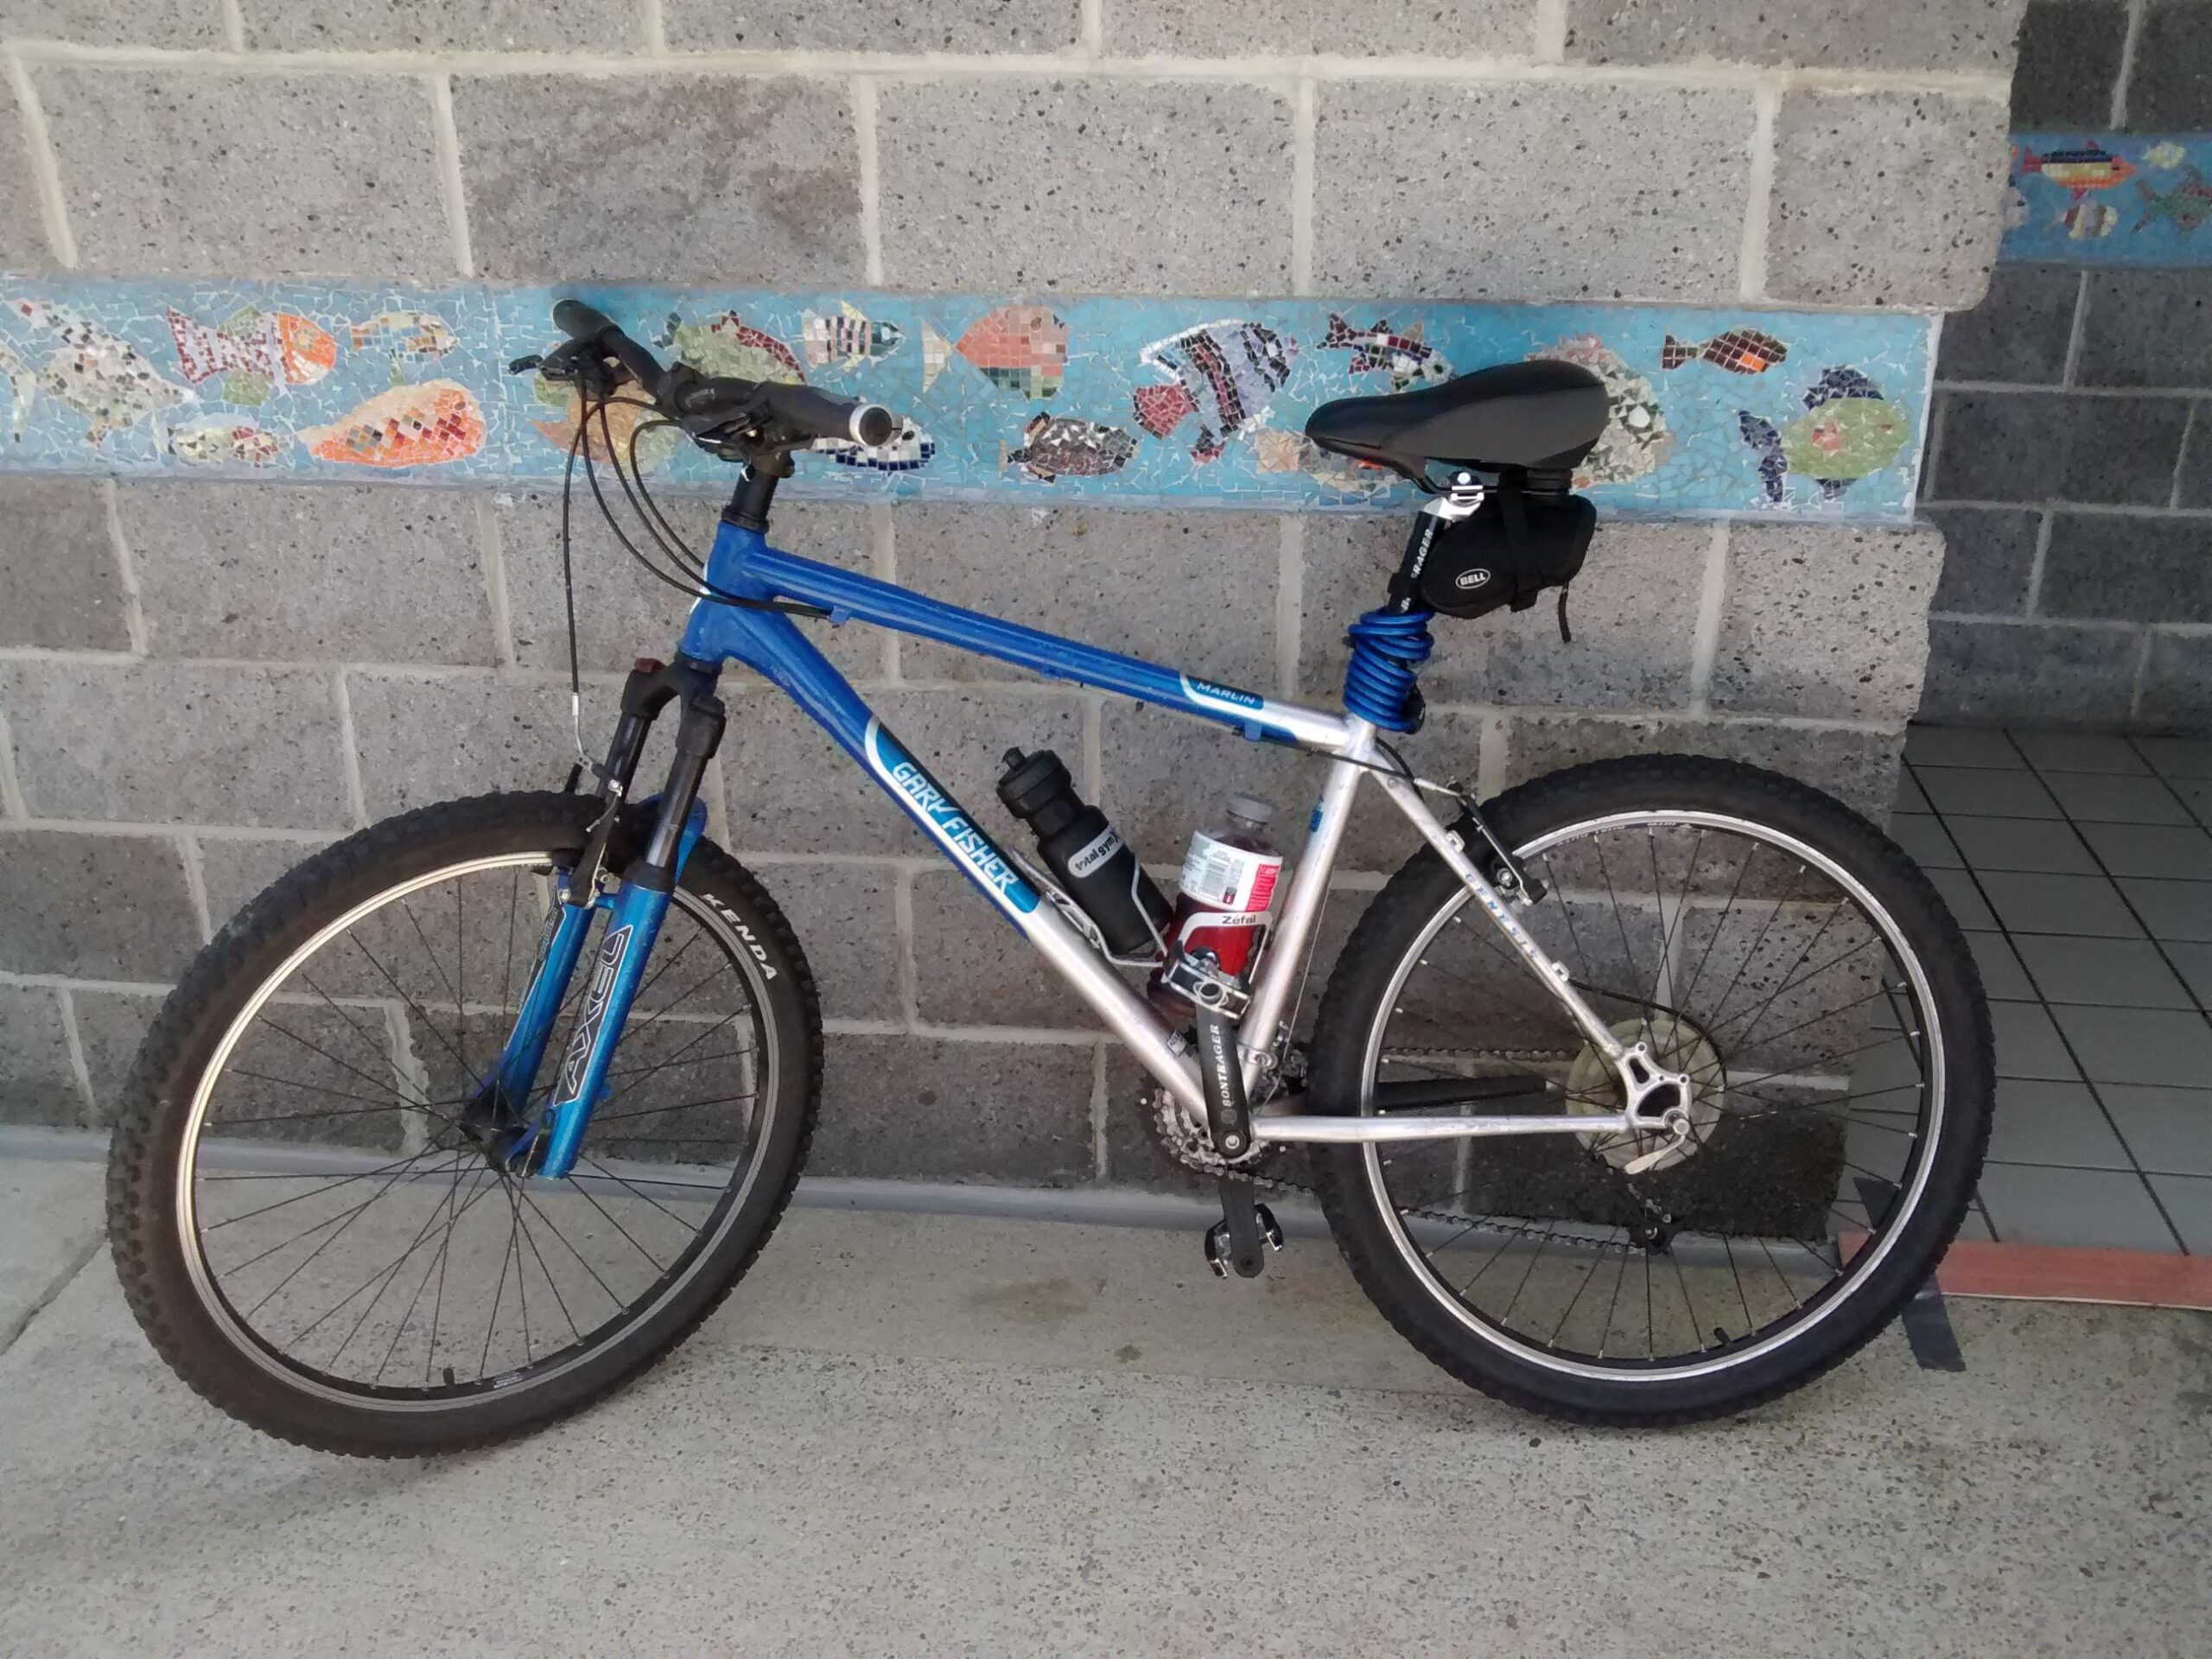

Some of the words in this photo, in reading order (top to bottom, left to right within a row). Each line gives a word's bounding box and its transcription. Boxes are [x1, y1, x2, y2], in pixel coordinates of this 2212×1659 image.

[1460, 572, 1487, 586] BELL
[1197, 682, 1255, 704] MARLIN
[893, 761, 961, 815] GARY
[942, 816, 1019, 895] FISHER
[698, 893, 779, 981] KENDA
[565, 933, 625, 1095] AXEL
[1210, 1023, 1231, 1107] BONTRAGER
